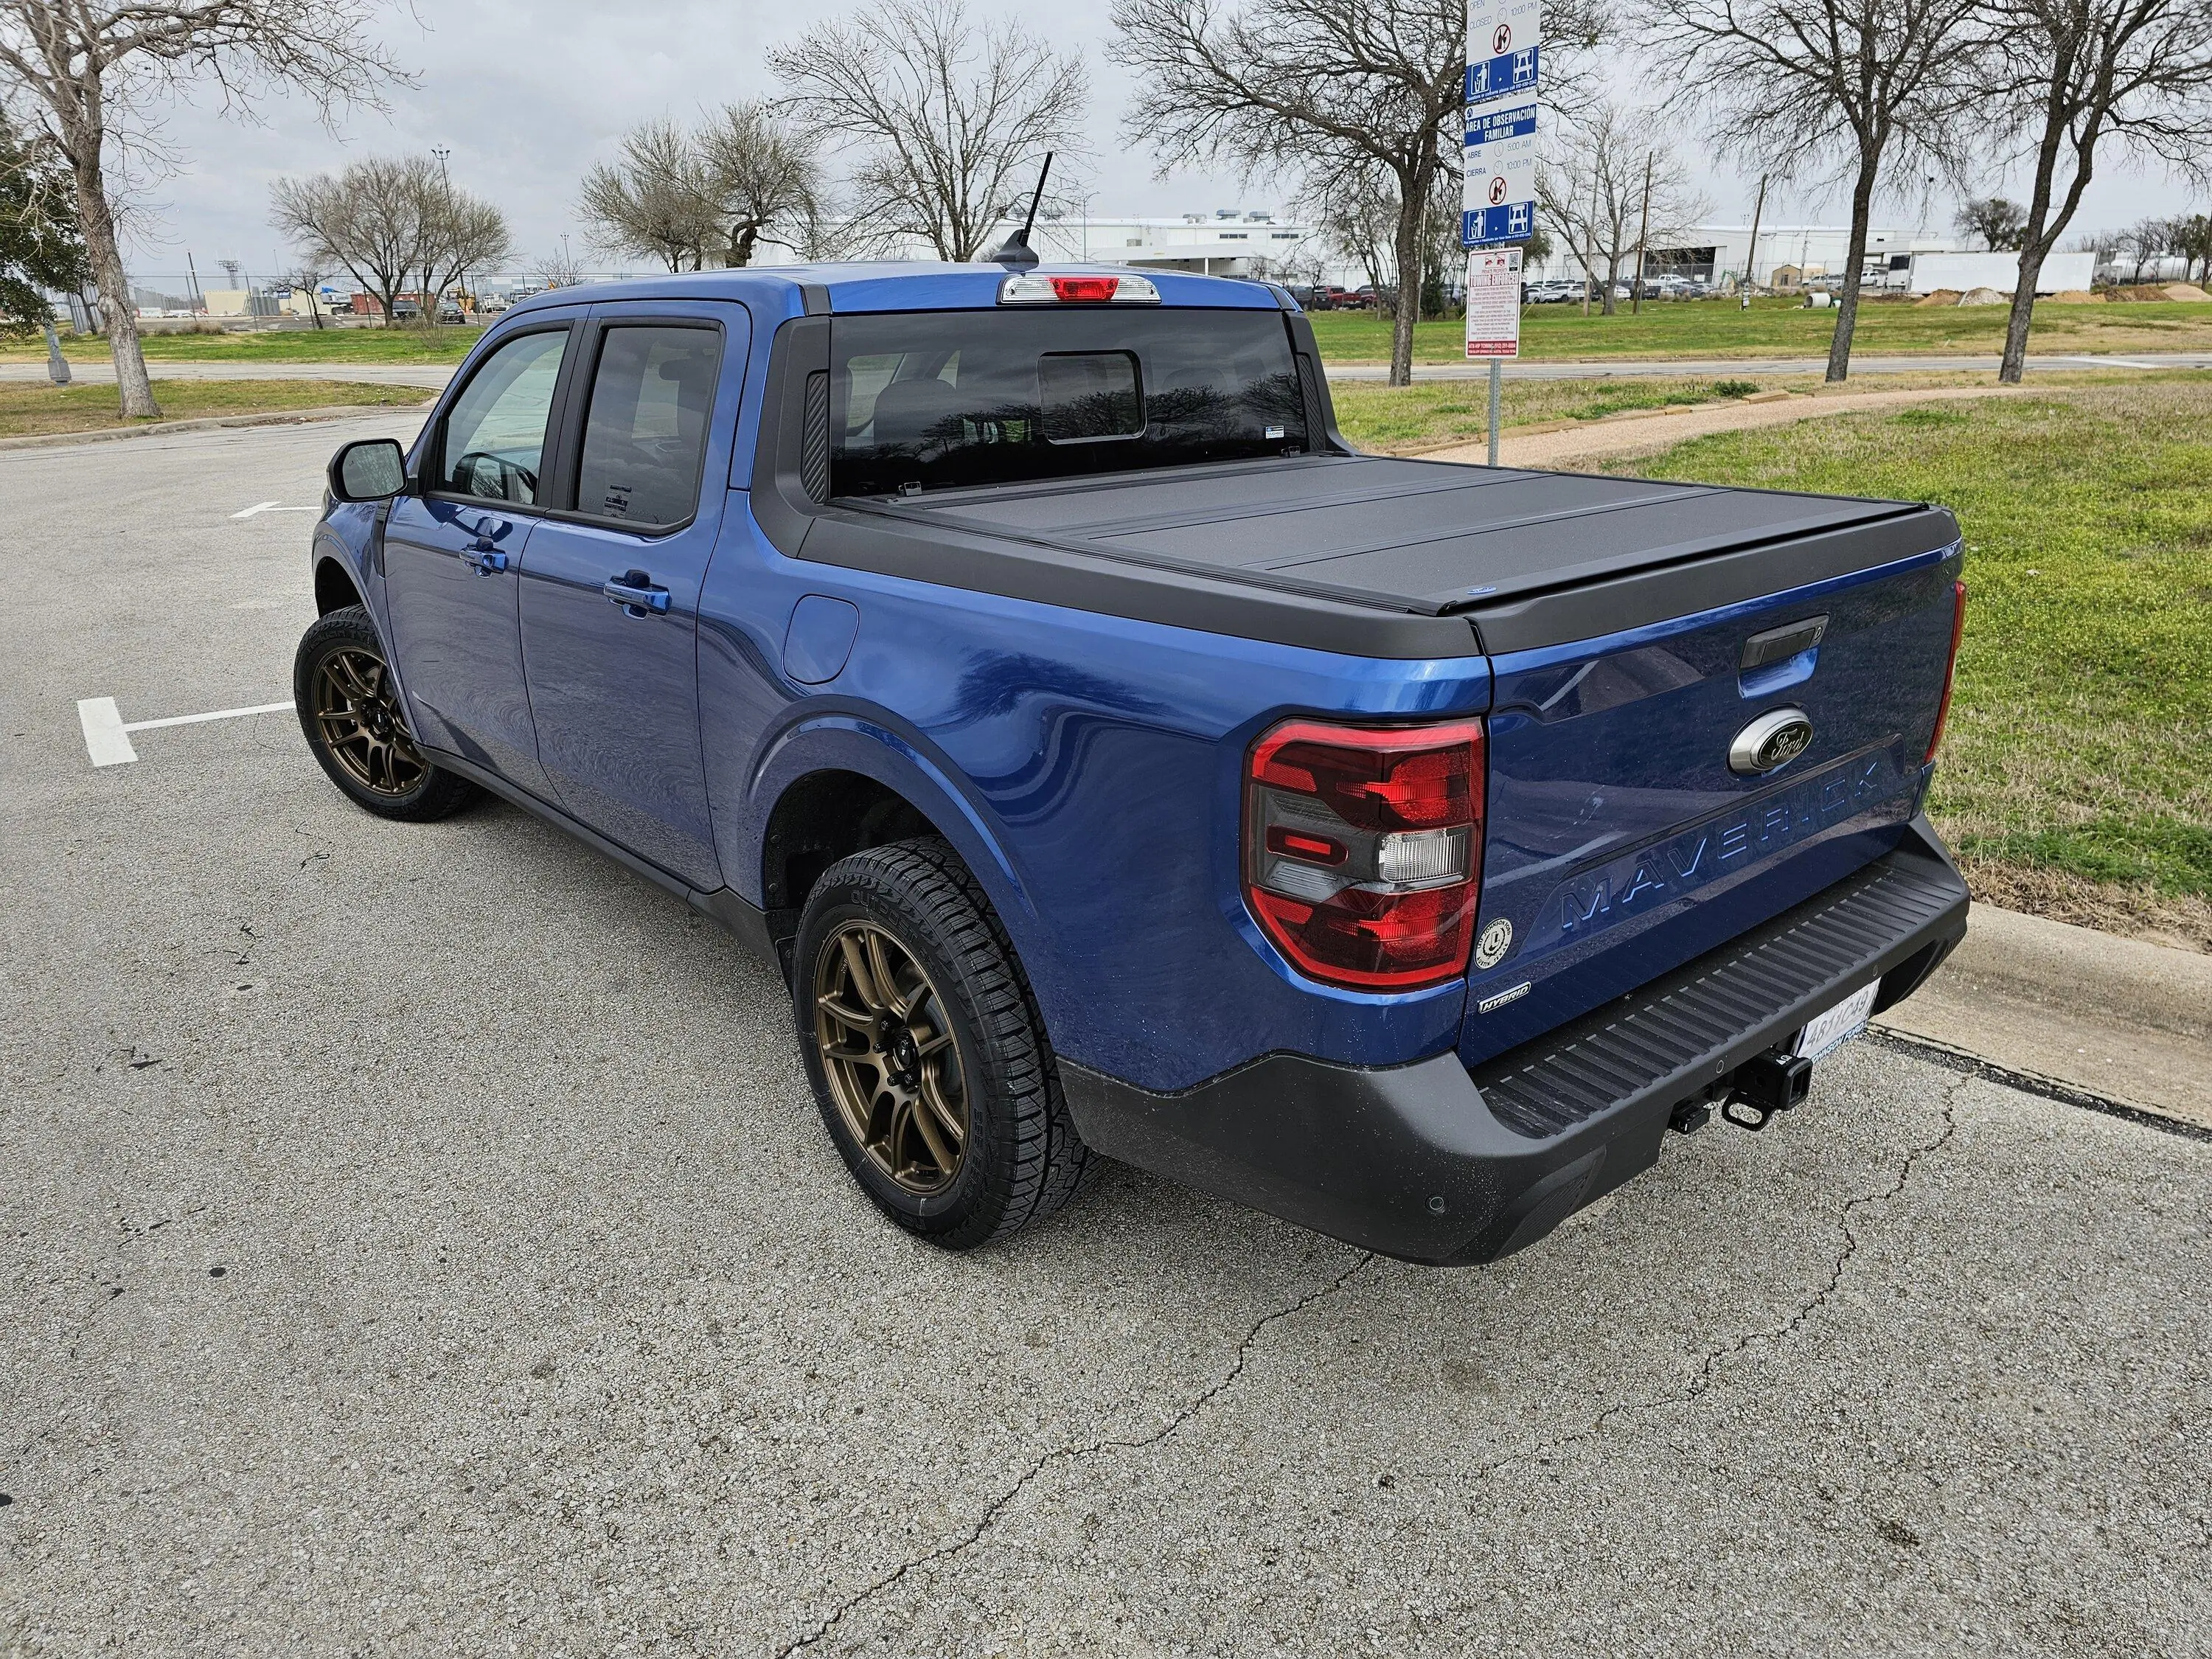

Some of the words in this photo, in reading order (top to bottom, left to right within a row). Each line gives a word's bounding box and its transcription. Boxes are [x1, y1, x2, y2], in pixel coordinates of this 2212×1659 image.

[1470, 0, 1485, 10] OPEN
[1470, 16, 1492, 29] CLOSED
[1512, 4, 1526, 15] 10:00
[1527, 1, 1537, 11] PM
[1466, 119, 1481, 133] ÁREA
[1483, 117, 1491, 129] DE
[1492, 105, 1536, 128] OBSERVACIÓN
[1484, 125, 1514, 142] FAMILIAR
[1467, 150, 1481, 160] ABRE
[1507, 142, 1520, 152] 5:00
[1522, 139, 1531, 148] AM
[1467, 167, 1486, 178] CIERRA
[1507, 160, 1521, 170] 10:00
[1523, 158, 1532, 167] PM
[1470, 274, 1492, 287] TOWING
[1492, 273, 1519, 286] ENFORCED
[1771, 728, 1805, 761] Ford
[1560, 761, 1878, 930] MAVERICK
[1484, 919, 1505, 937] JOHNSON
[1482, 985, 1529, 1012] HYBRID
[1811, 1035, 1845, 1063] OHNSON
